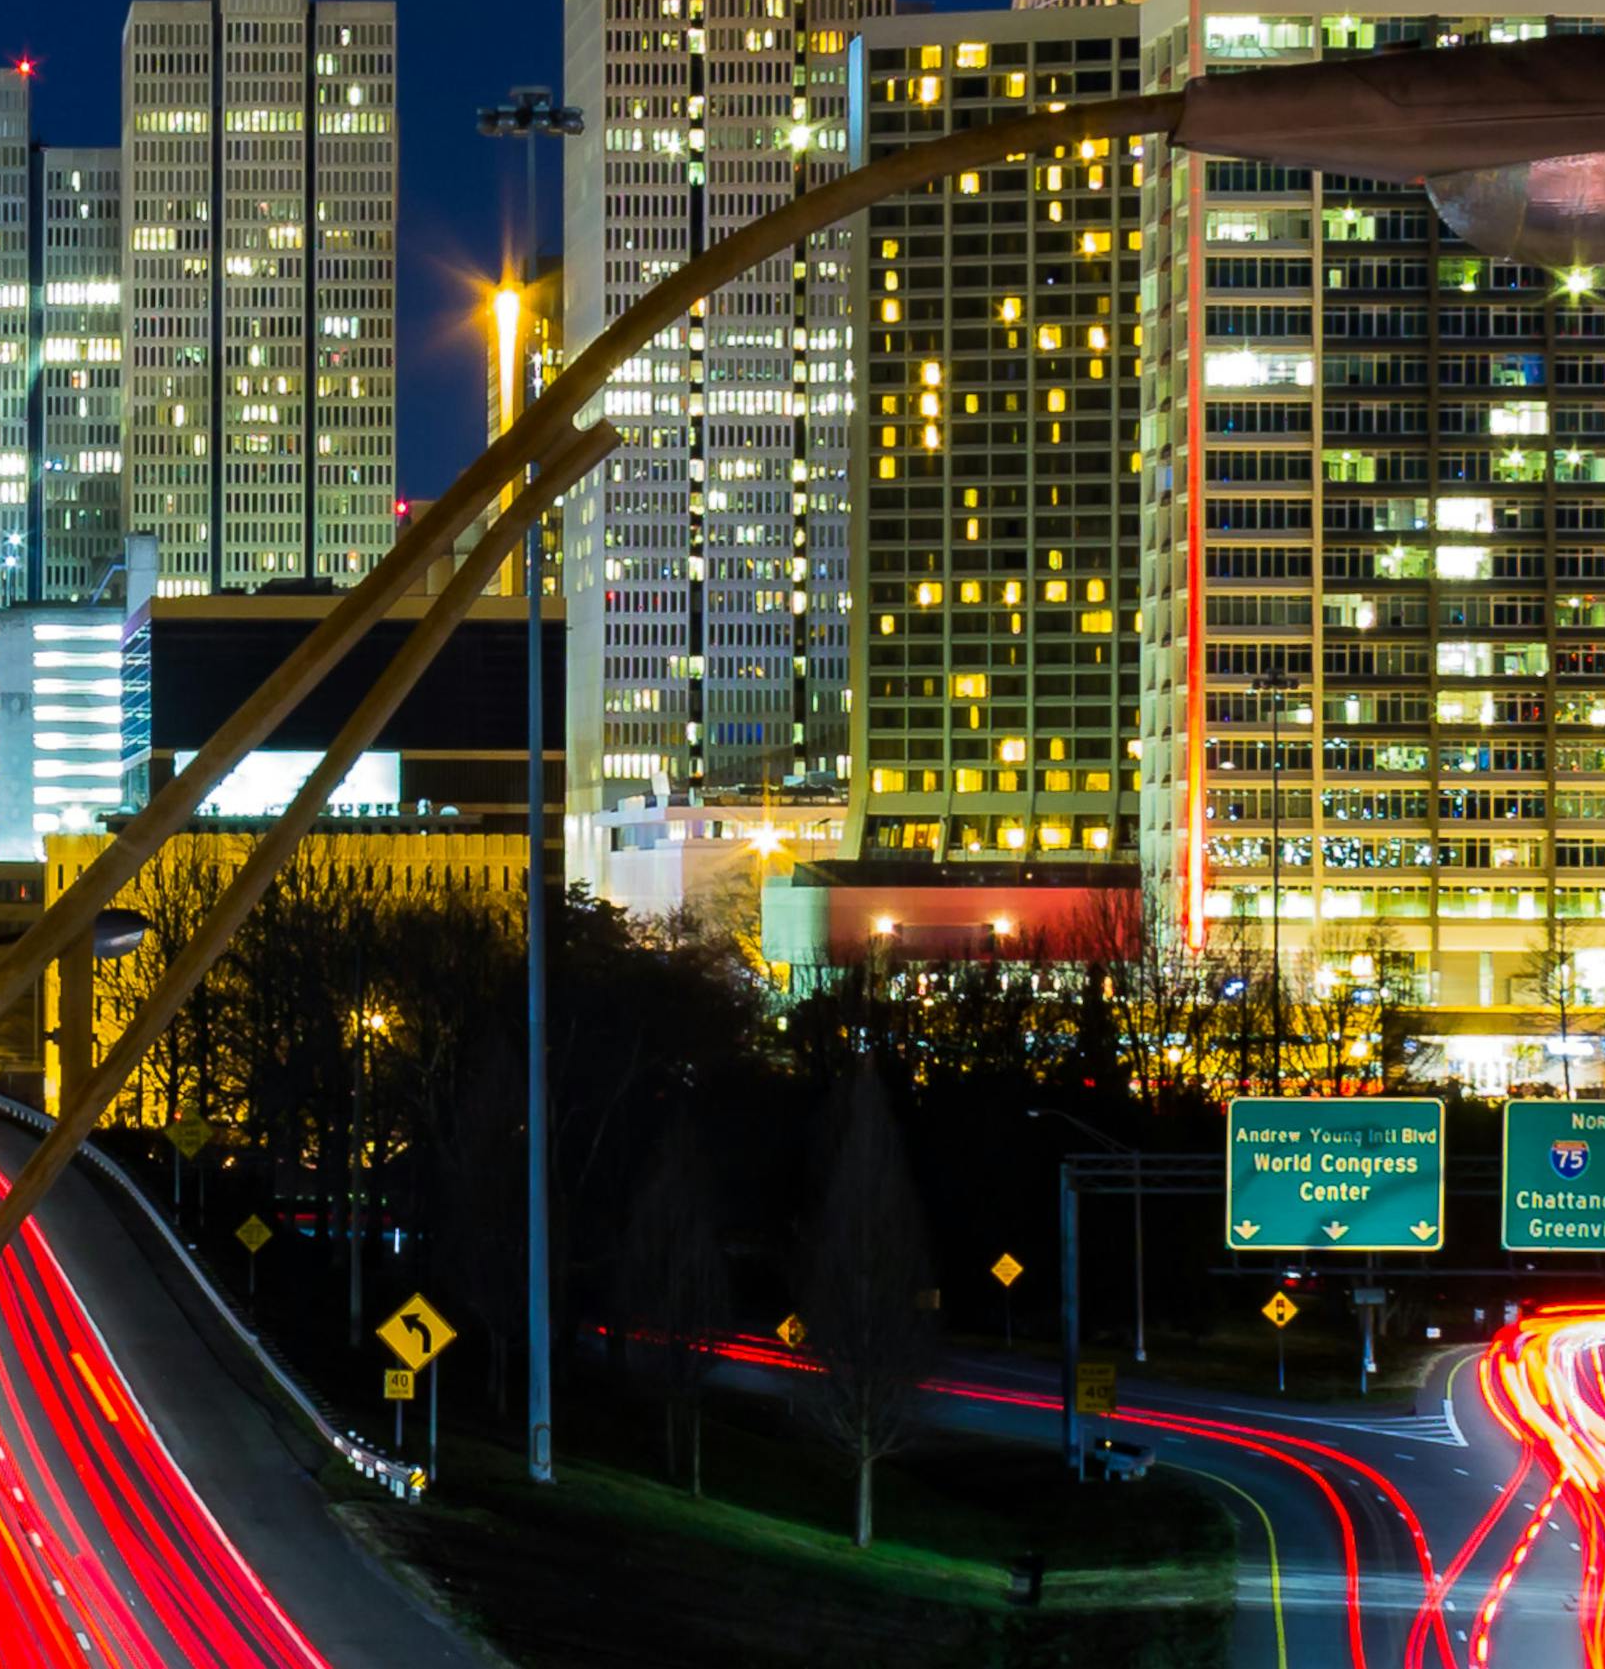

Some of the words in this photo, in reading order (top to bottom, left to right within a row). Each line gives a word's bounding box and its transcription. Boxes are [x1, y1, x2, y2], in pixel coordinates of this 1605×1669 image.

[1236, 1128, 1301, 1143] Andrew
[1310, 1128, 1363, 1147] Young
[1402, 1128, 1437, 1144] Blvd
[1254, 1153, 1312, 1173] World
[1320, 1154, 1418, 1178] Congress
[1556, 1150, 1583, 1169] 75
[1300, 1182, 1371, 1202] Center
[392, 1374, 408, 1388] 40
